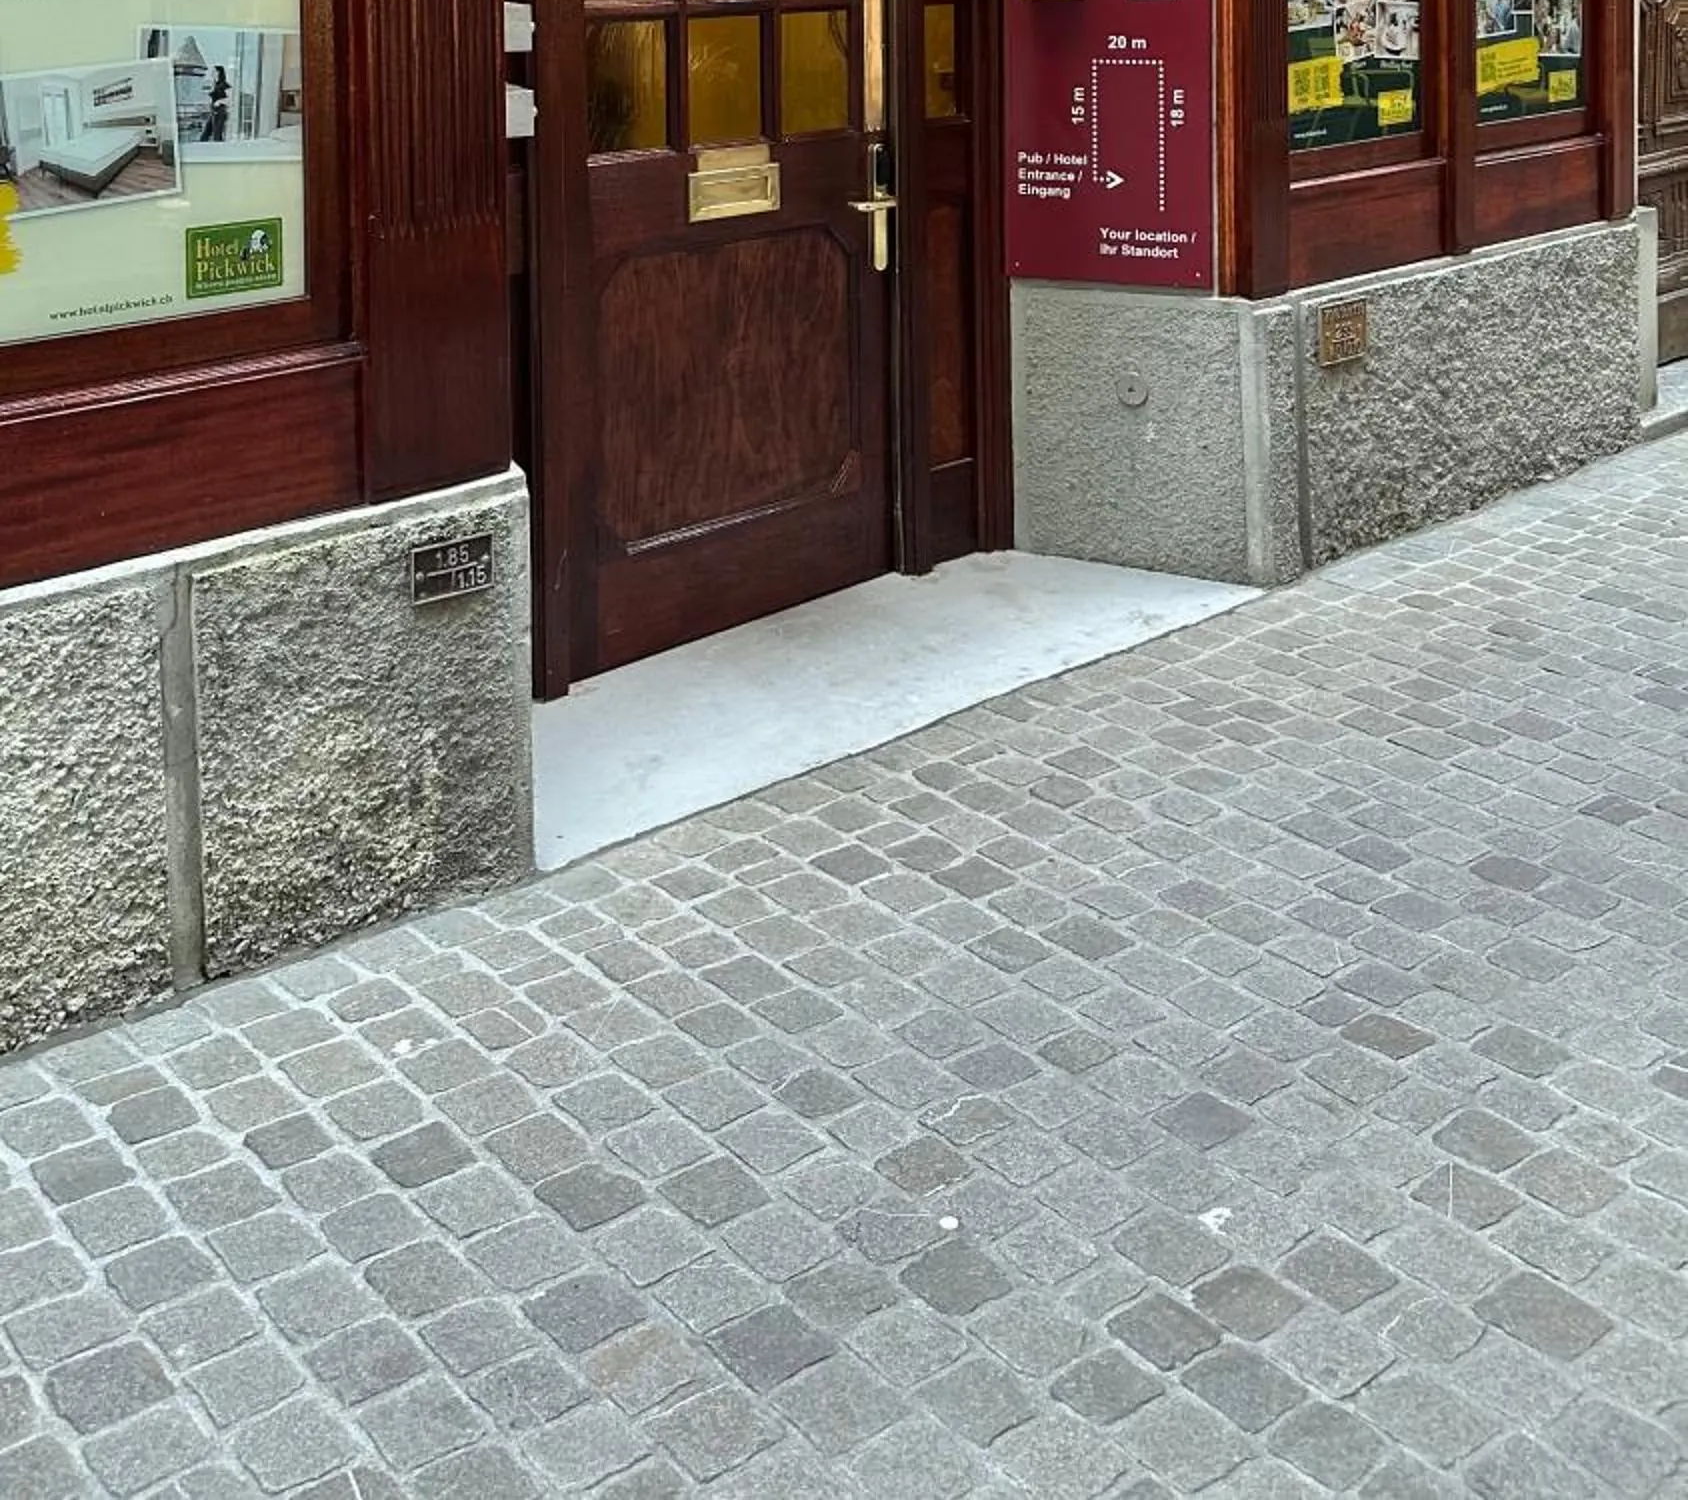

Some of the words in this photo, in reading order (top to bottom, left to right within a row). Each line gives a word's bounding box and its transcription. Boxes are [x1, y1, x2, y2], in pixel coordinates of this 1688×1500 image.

[1107, 36, 1127, 49] 20
[1131, 37, 1147, 49] m
[1074, 87, 1085, 102] m
[1173, 88, 1185, 104] m
[1072, 105, 1084, 125] 15
[1170, 109, 1184, 127] 18
[1018, 151, 1044, 165] Pub
[1053, 153, 1087, 166] Hotel
[1018, 167, 1075, 182] Entrance
[1018, 183, 1071, 200] Eingang
[1100, 227, 1132, 240] Your
[1135, 229, 1188, 244] location
[1121, 243, 1180, 259] Standort
